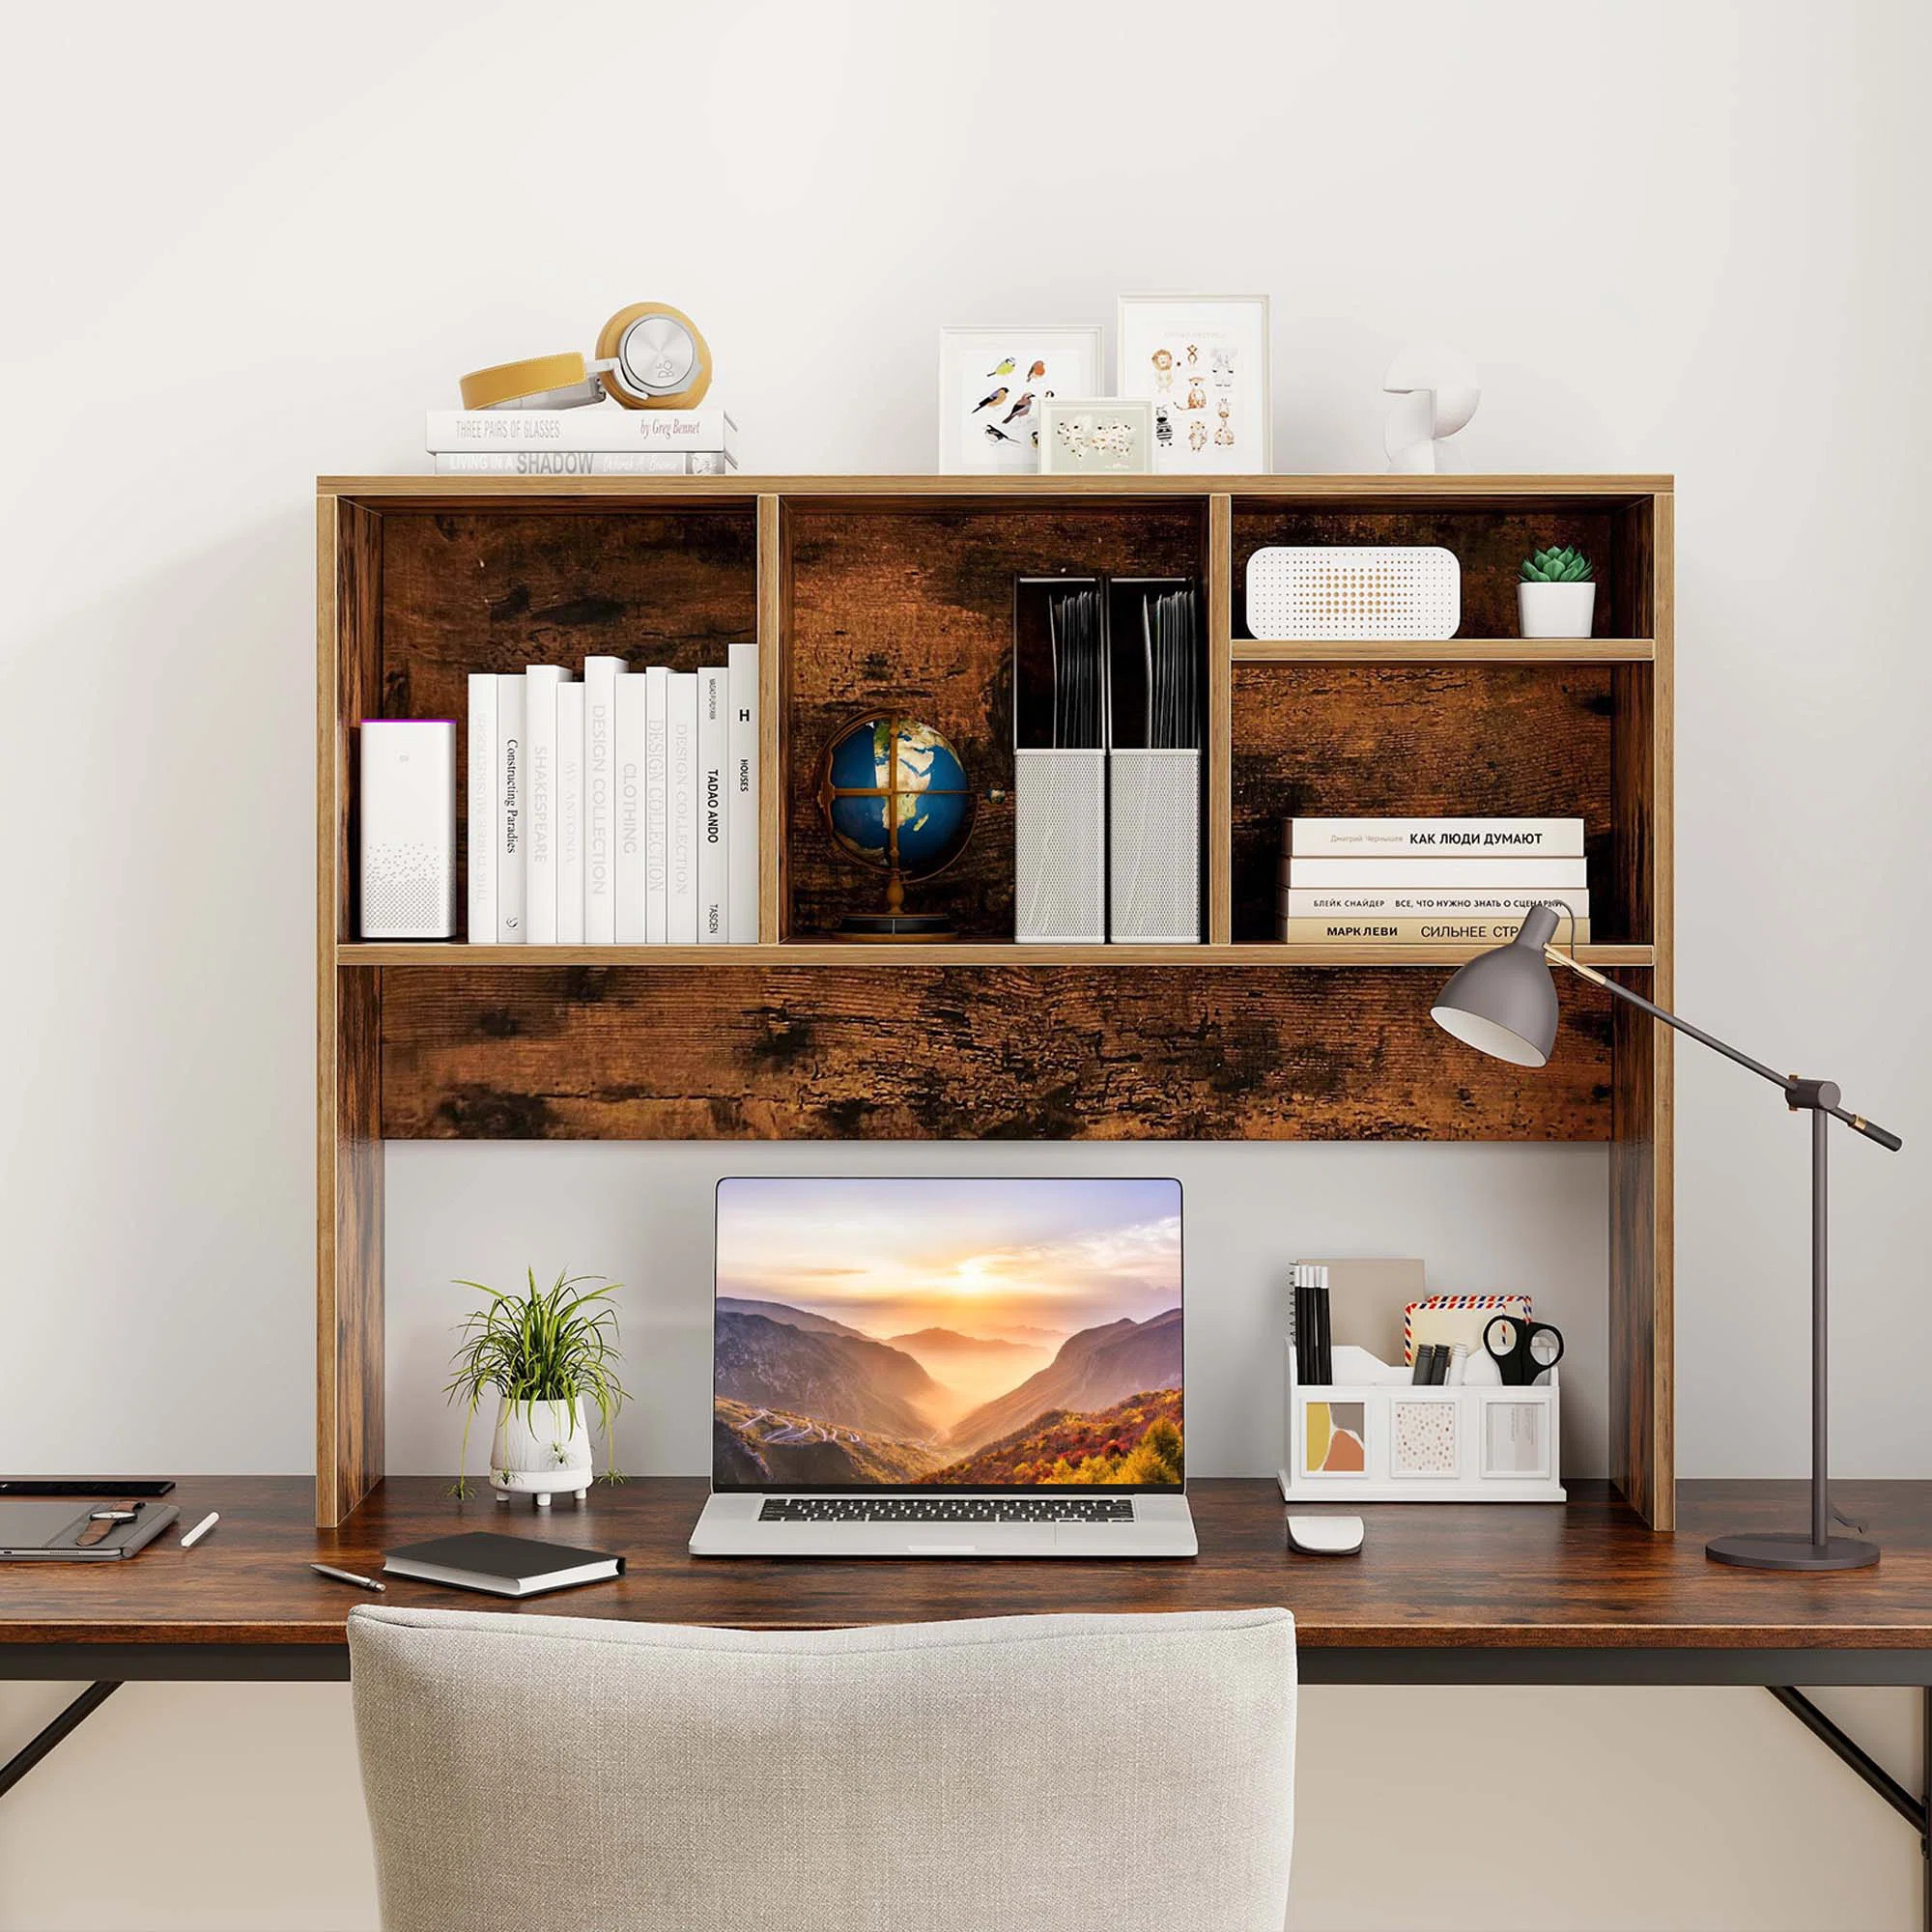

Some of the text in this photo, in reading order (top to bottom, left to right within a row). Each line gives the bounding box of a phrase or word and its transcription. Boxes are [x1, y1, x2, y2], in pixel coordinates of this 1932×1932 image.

[456, 420, 560, 439] THREE PAIRS OF GLASSES
[640, 418, 700, 440] by Greg Bennet
[517, 453, 594, 474] SHADOW
[504, 739, 518, 854] Constructing Paradies
[533, 746, 548, 864] SHAKESPEARE
[591, 706, 606, 895] DESIGN COLLECTION
[623, 763, 637, 854] CLOTHING
[648, 720, 665, 893] DESIGN COLLECTION
[675, 724, 687, 895] DESIGN COLLECTION
[707, 769, 719, 843] TADAO ANDO
[1409, 833, 1543, 845] КАК ЛЮДИ ДУМАЮТ
[1313, 897, 1385, 909] БЛЕЙК СНАЙДЕР
[1416, 899, 1435, 908] ЧТО
[1436, 899, 1471, 908] НУЖНО
[1473, 899, 1501, 908] ЗНАТЬ
[1503, 899, 1511, 908] О
[709, 904, 718, 934] TASCEN
[1327, 926, 1398, 936] МАРК ЛЕВИ
[1421, 925, 1487, 938] СИЛЬНЕЕ
